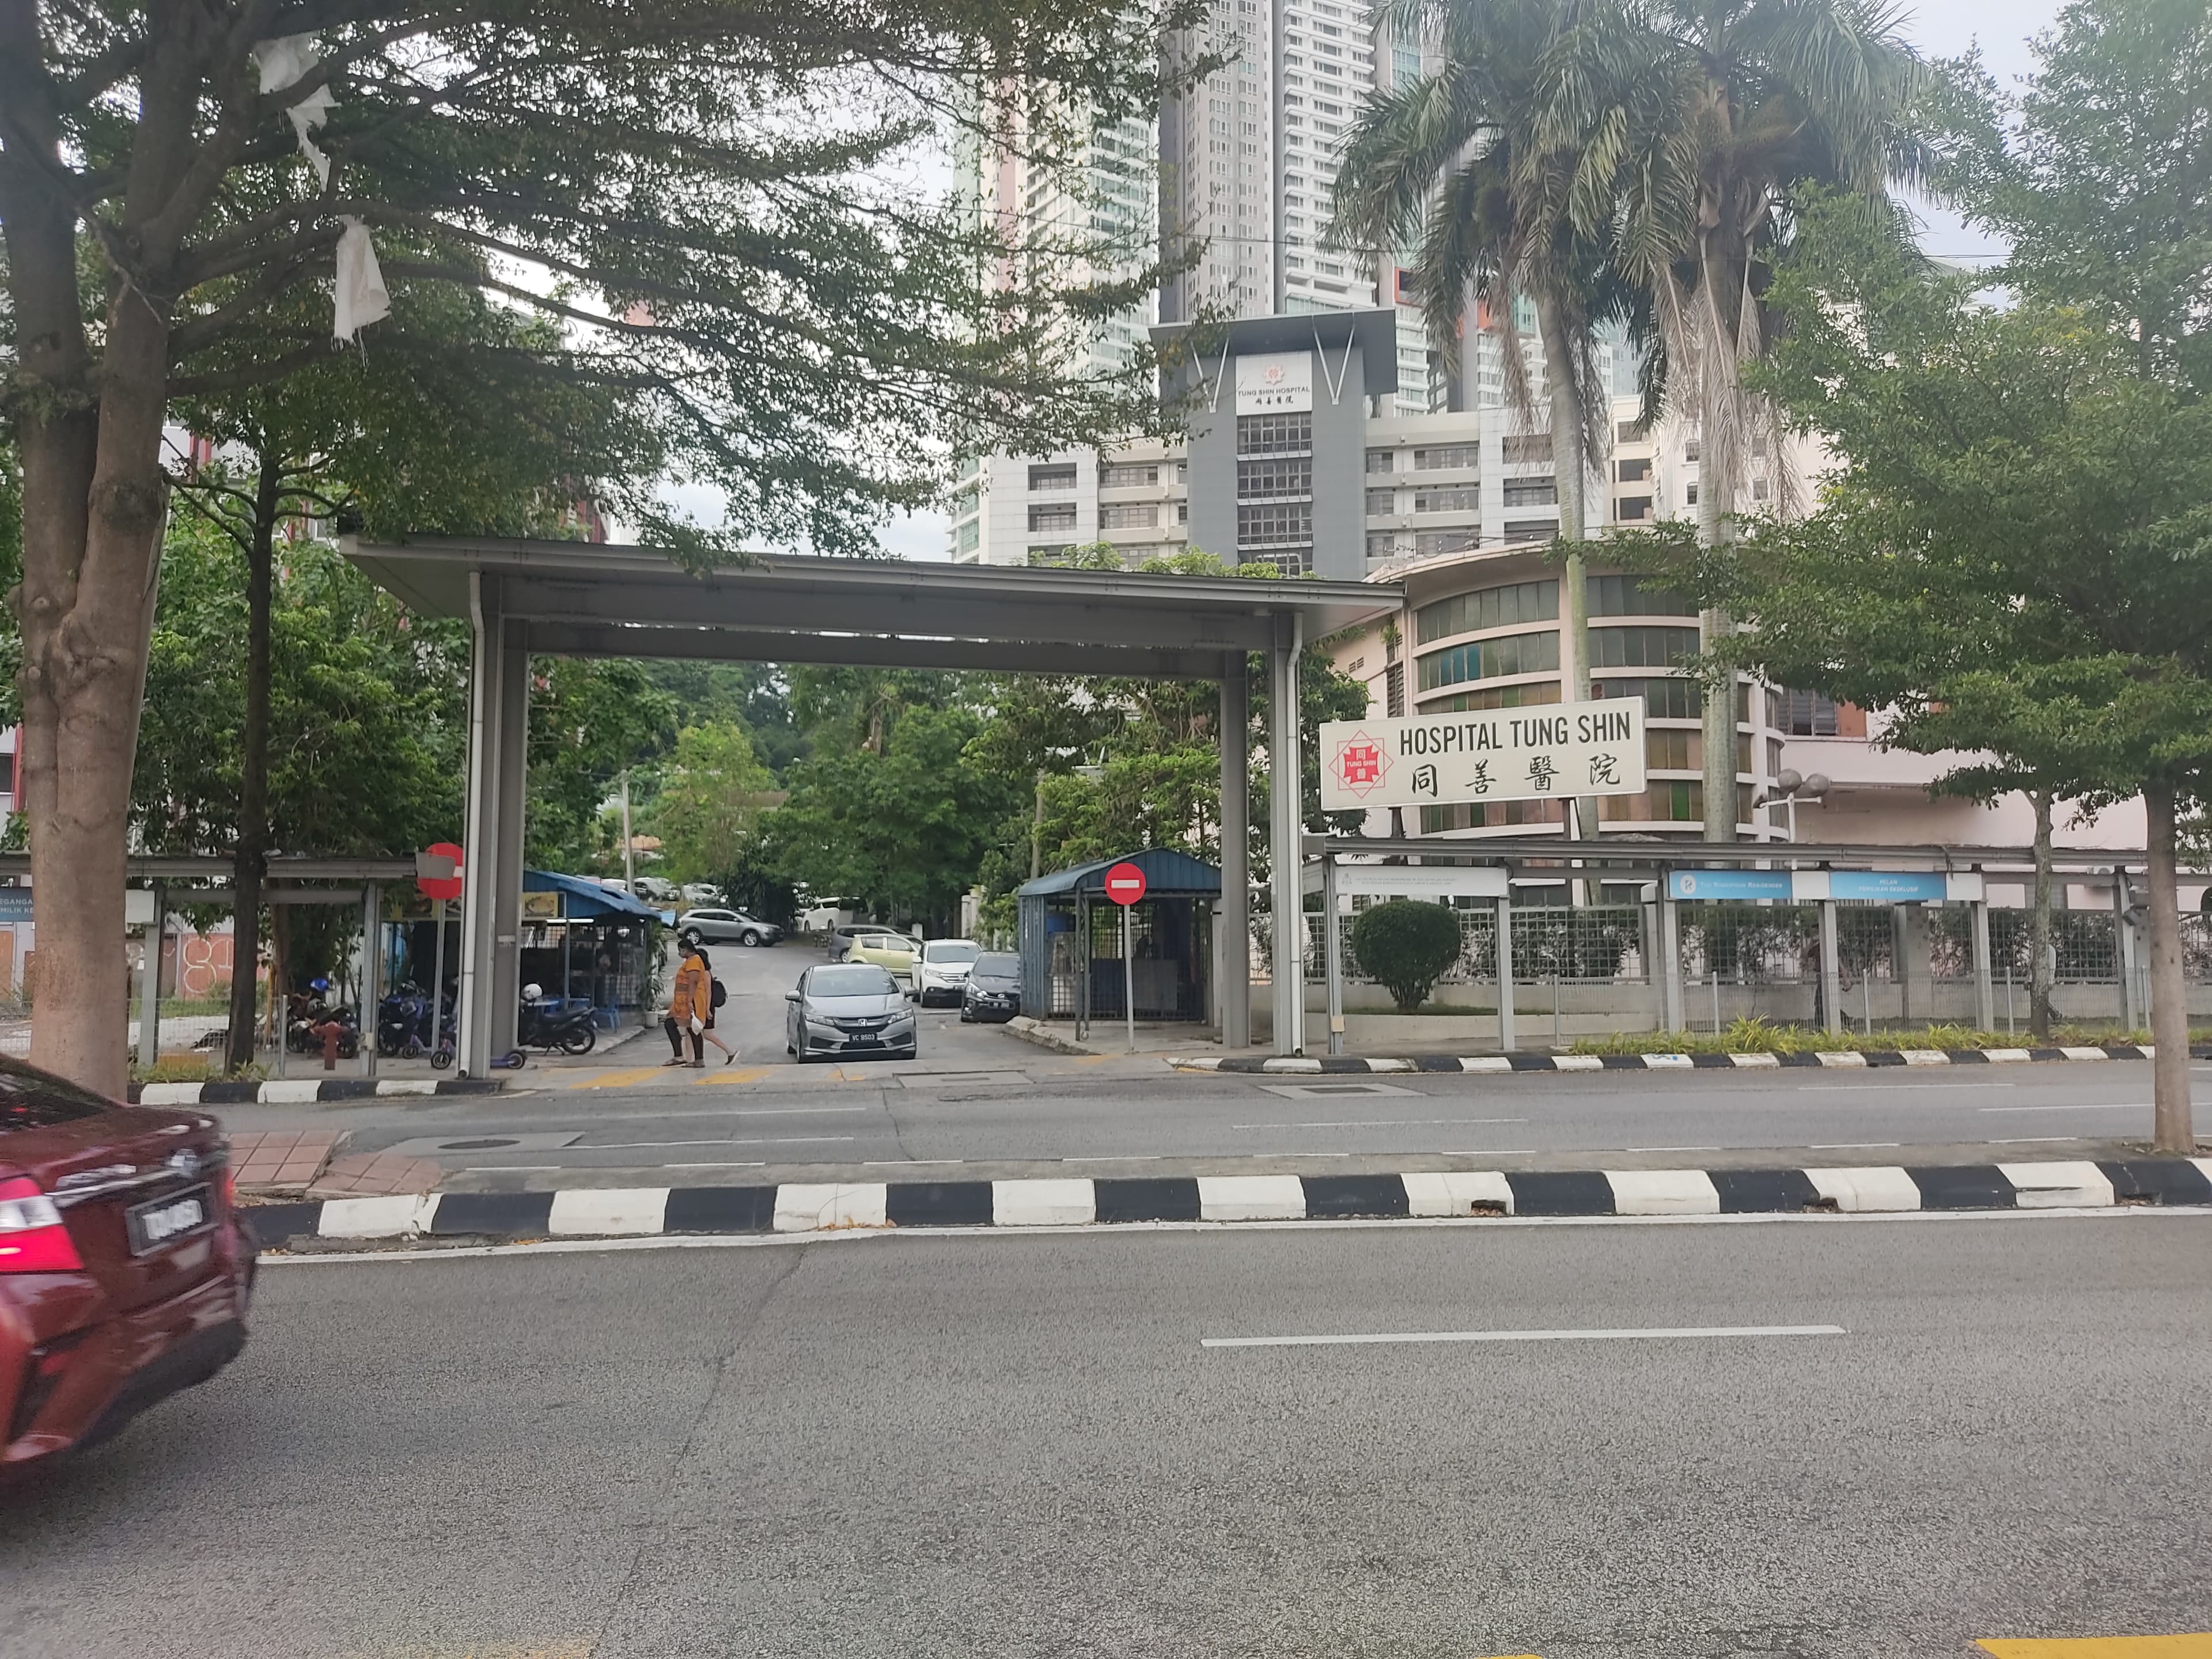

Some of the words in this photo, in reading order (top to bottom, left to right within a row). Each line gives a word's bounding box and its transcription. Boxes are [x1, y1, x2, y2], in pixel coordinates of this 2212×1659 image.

[1276, 387, 1310, 395] HOSPITAL
[1400, 722, 1503, 756] HOSPITAL
[1509, 717, 1569, 748] TUNG
[1577, 711, 1631, 743] SHIN
[1411, 753, 1621, 797] 同善醫院
